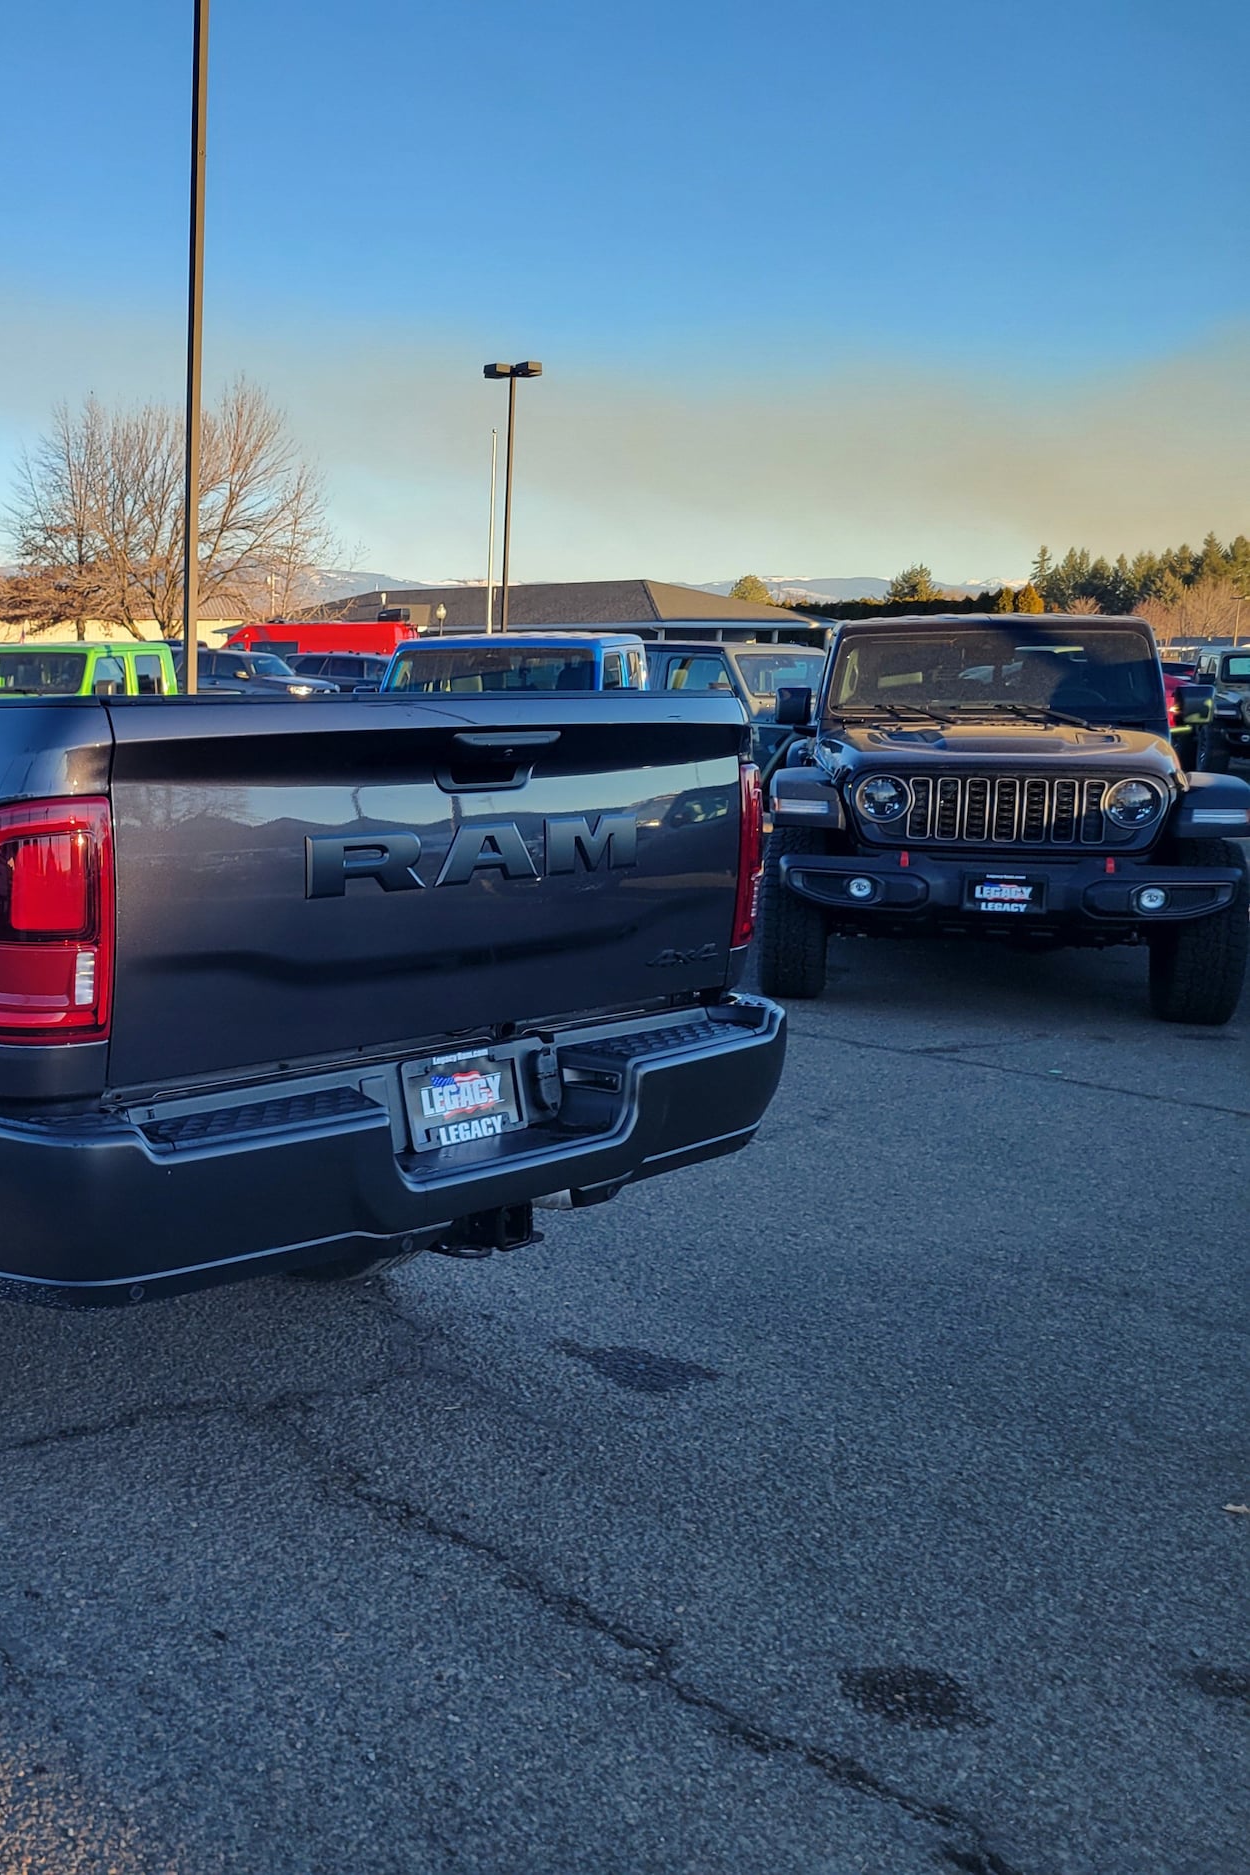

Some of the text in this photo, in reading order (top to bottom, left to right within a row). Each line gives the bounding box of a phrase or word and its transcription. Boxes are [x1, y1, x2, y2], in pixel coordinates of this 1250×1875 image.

[305, 813, 638, 899] RAM
[975, 885, 1033, 900] LEGACY
[981, 902, 1027, 912] LEGACY
[421, 1075, 501, 1117] LEGACY
[439, 1115, 502, 1145] LEGACY
